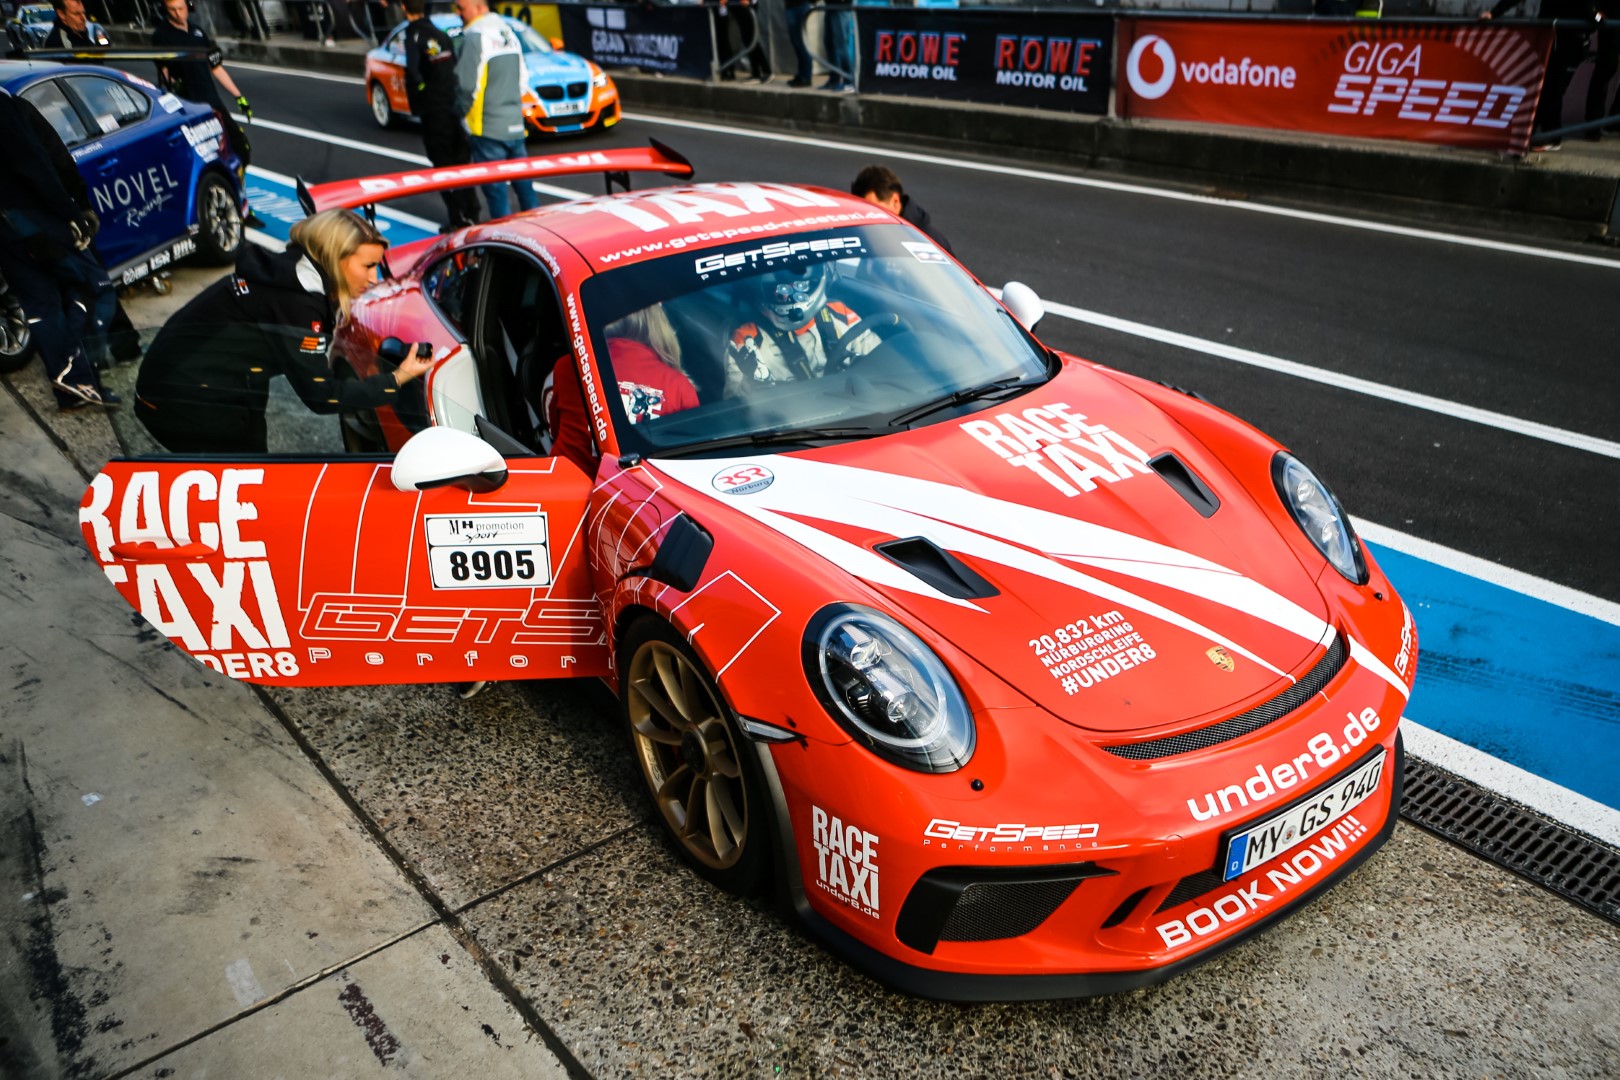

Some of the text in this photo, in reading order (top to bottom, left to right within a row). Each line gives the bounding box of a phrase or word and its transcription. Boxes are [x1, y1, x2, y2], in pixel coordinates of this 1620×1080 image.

[875, 30, 961, 66] ROWE
[876, 62, 957, 81] MOTOR OIL
[995, 35, 1098, 76] ROWE
[1344, 41, 1422, 77] GIGA
[996, 70, 1088, 92] MOTOR OIL
[1181, 57, 1297, 89] vodafone
[1327, 74, 1527, 128] SPEED
[92, 163, 179, 213] NOVEL
[599, 211, 890, 264] www.getspeed-racetaxi.de
[566, 292, 608, 442] www.getspeed.de
[958, 402, 1111, 459] RACE
[717, 467, 768, 486] RSR
[731, 480, 770, 494] Nürburg
[1006, 430, 1156, 498] TAXI
[475, 521, 525, 532] promotion
[449, 549, 536, 581] 8905
[299, 592, 607, 645] GETS
[1028, 609, 1125, 656] 20,832 km
[308, 647, 615, 669] Perfor
[1039, 621, 1134, 668] NÜRBURGRING
[1049, 631, 1144, 679] NORDSCHLEIFE
[1060, 642, 1157, 696] #UNDER8
[1186, 706, 1381, 822] under8.de
[812, 804, 879, 873] RACE
[1231, 760, 1382, 872] D MY GS 940
[813, 841, 880, 911] TAXI
[815, 879, 881, 920] under8.de
[1155, 814, 1368, 949] BOOK NOW!!!
